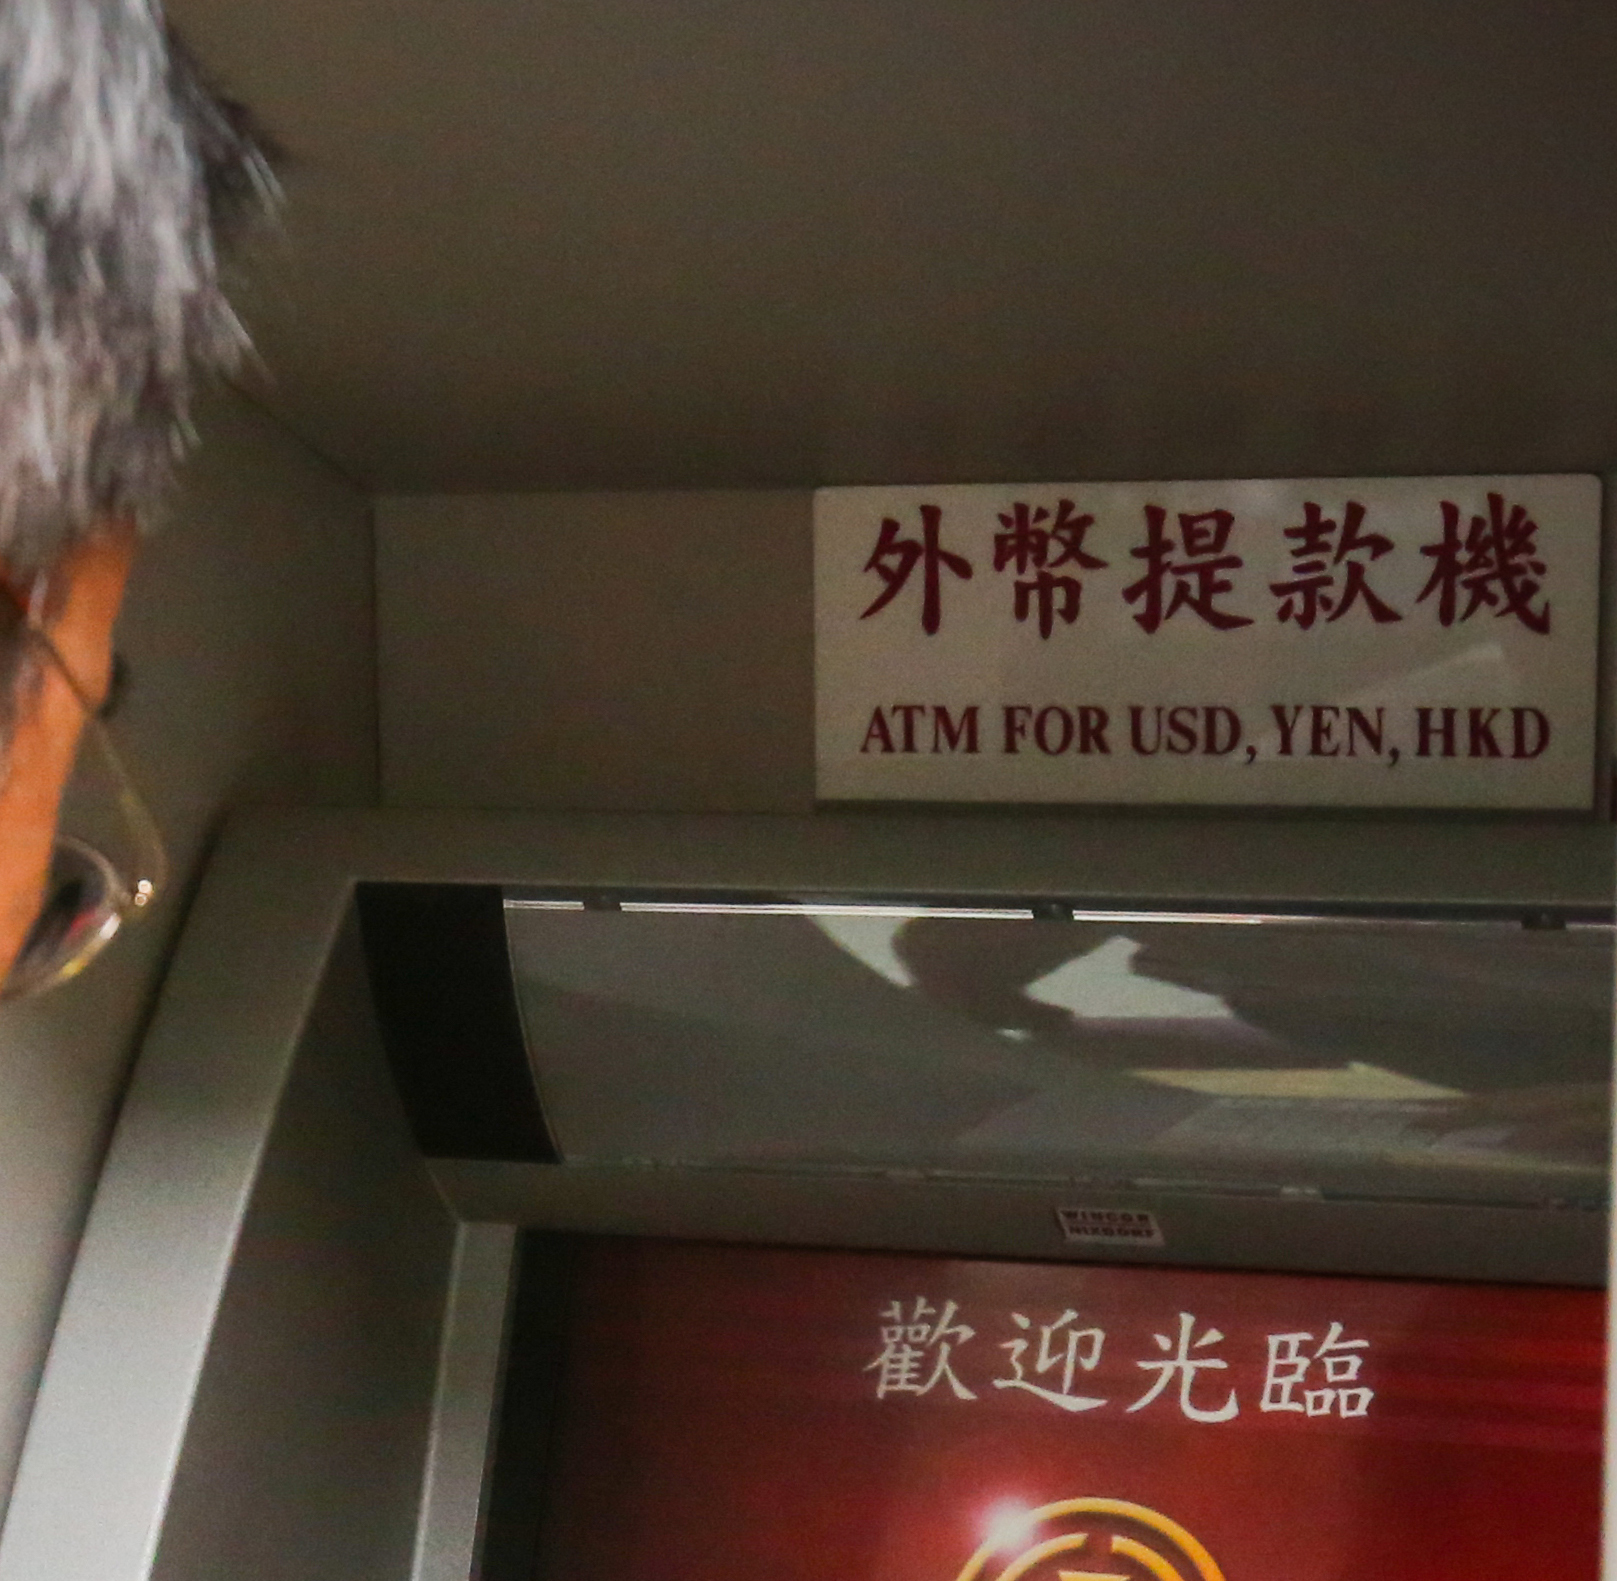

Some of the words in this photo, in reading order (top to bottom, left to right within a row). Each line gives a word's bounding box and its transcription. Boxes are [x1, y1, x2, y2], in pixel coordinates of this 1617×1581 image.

[859, 491, 1551, 640] 外幣提款機
[860, 705, 980, 755] ATM
[1002, 705, 1112, 757] FOR
[1128, 706, 1257, 765] USD,
[1270, 706, 1400, 769] YEN,
[1415, 706, 1551, 760] HKD
[864, 1297, 1376, 1423] 歡迎光臨
